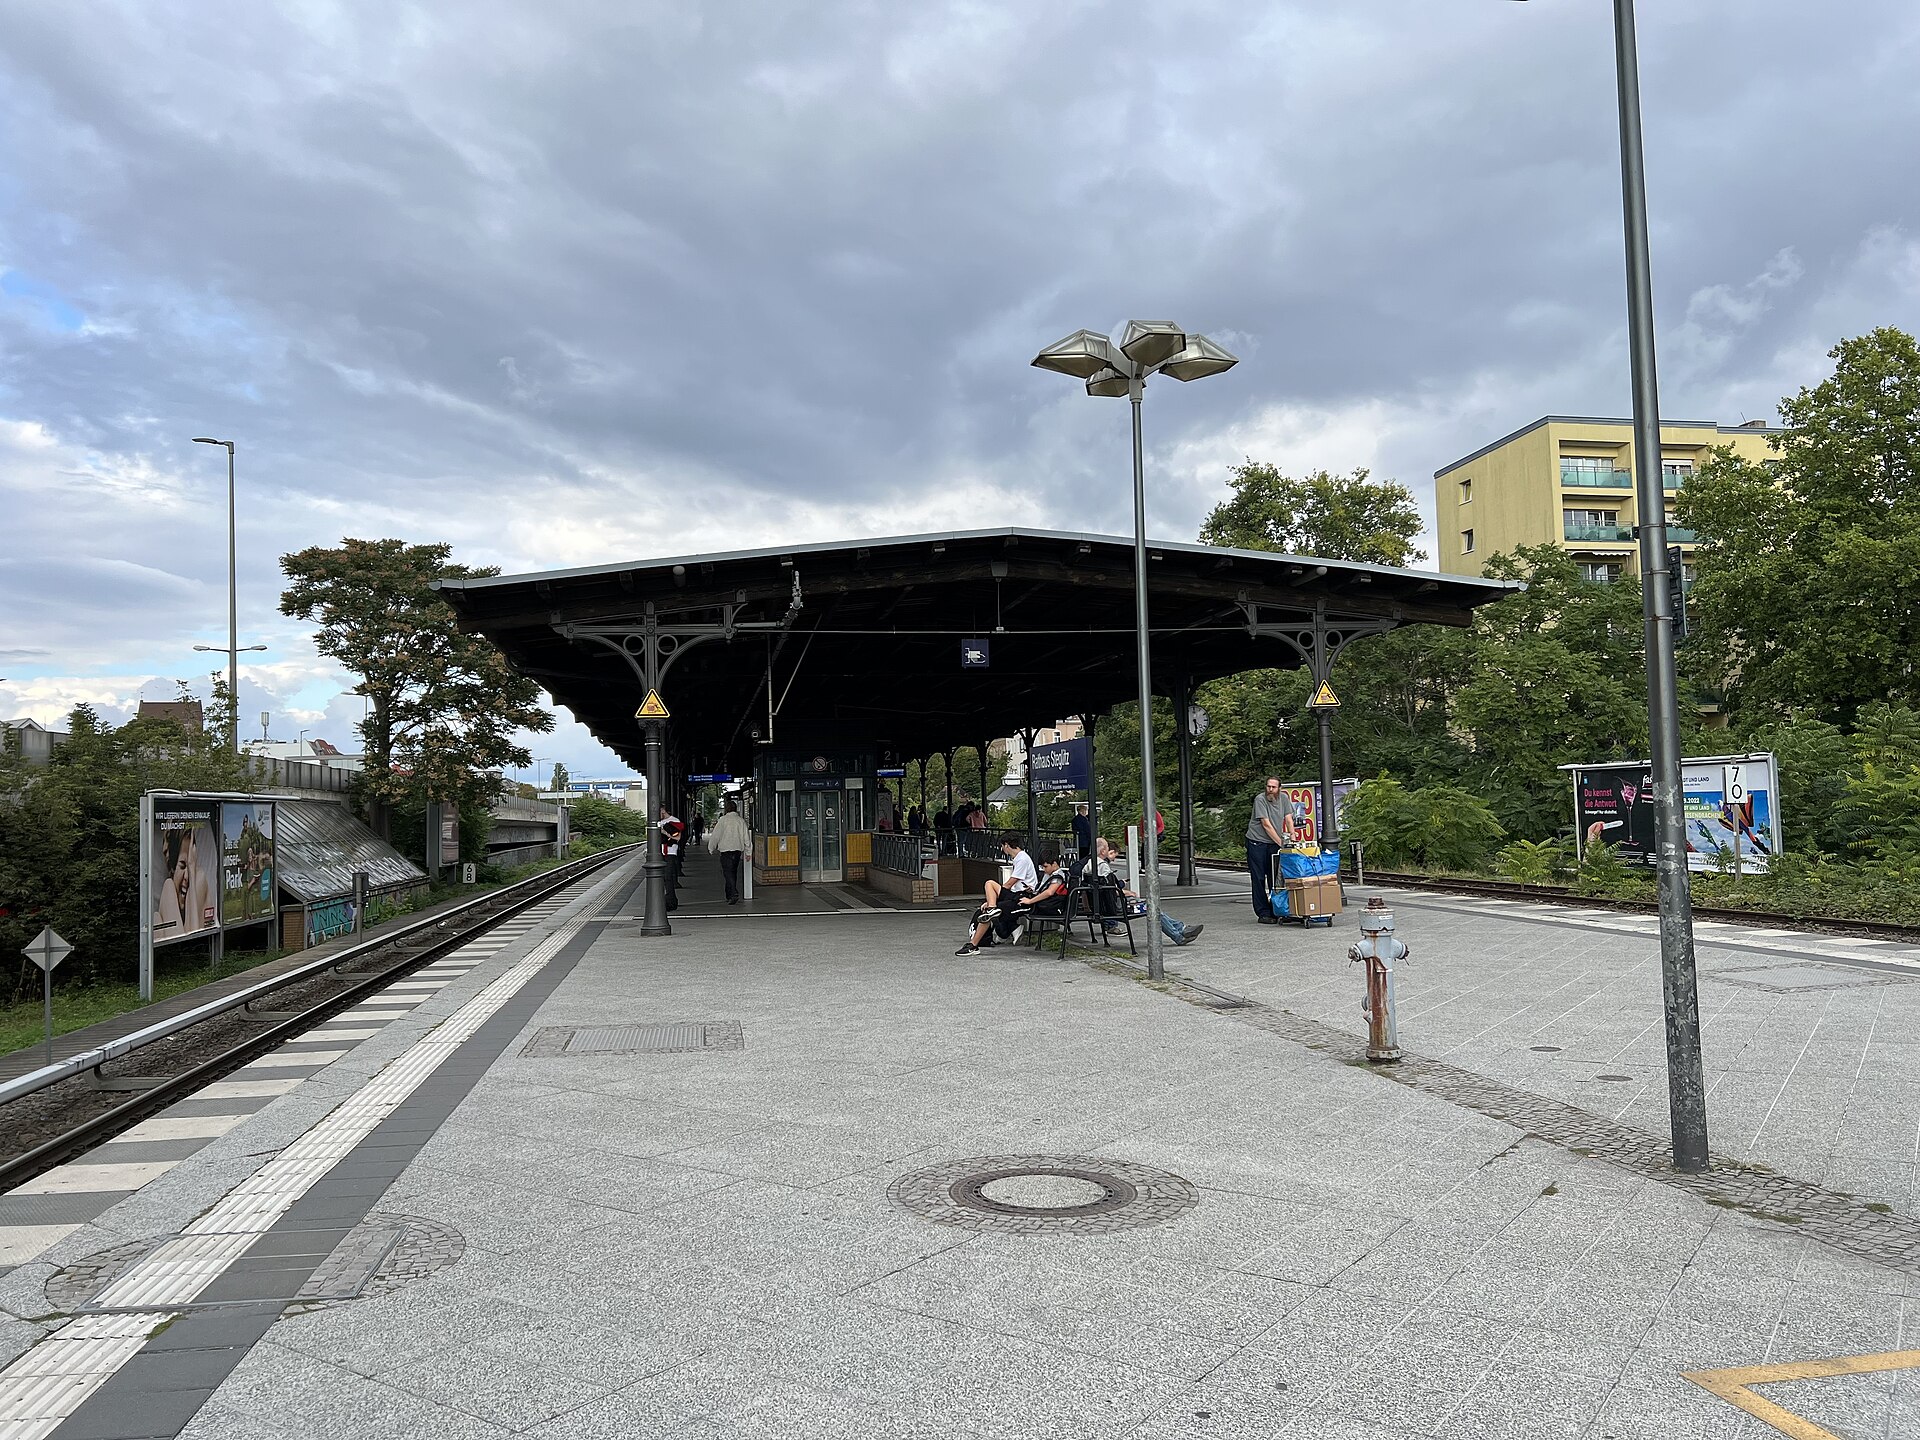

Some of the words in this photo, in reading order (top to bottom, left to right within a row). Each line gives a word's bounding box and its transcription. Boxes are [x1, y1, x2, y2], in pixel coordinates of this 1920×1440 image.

[1032, 752, 1050, 770] Rathaus
[1050, 748, 1070, 770] Steglitz
[1731, 766, 1740, 783] 7
[1584, 789, 1592, 797] Du
[1593, 788, 1612, 797] kennst
[1731, 784, 1742, 799] 0
[1584, 800, 1593, 808] die
[180, 811, 194, 819] DEINEN
[161, 822, 167, 830] DU
[168, 822, 185, 830] MACHST
[225, 867, 243, 890] Park
[466, 873, 472, 881] 8
